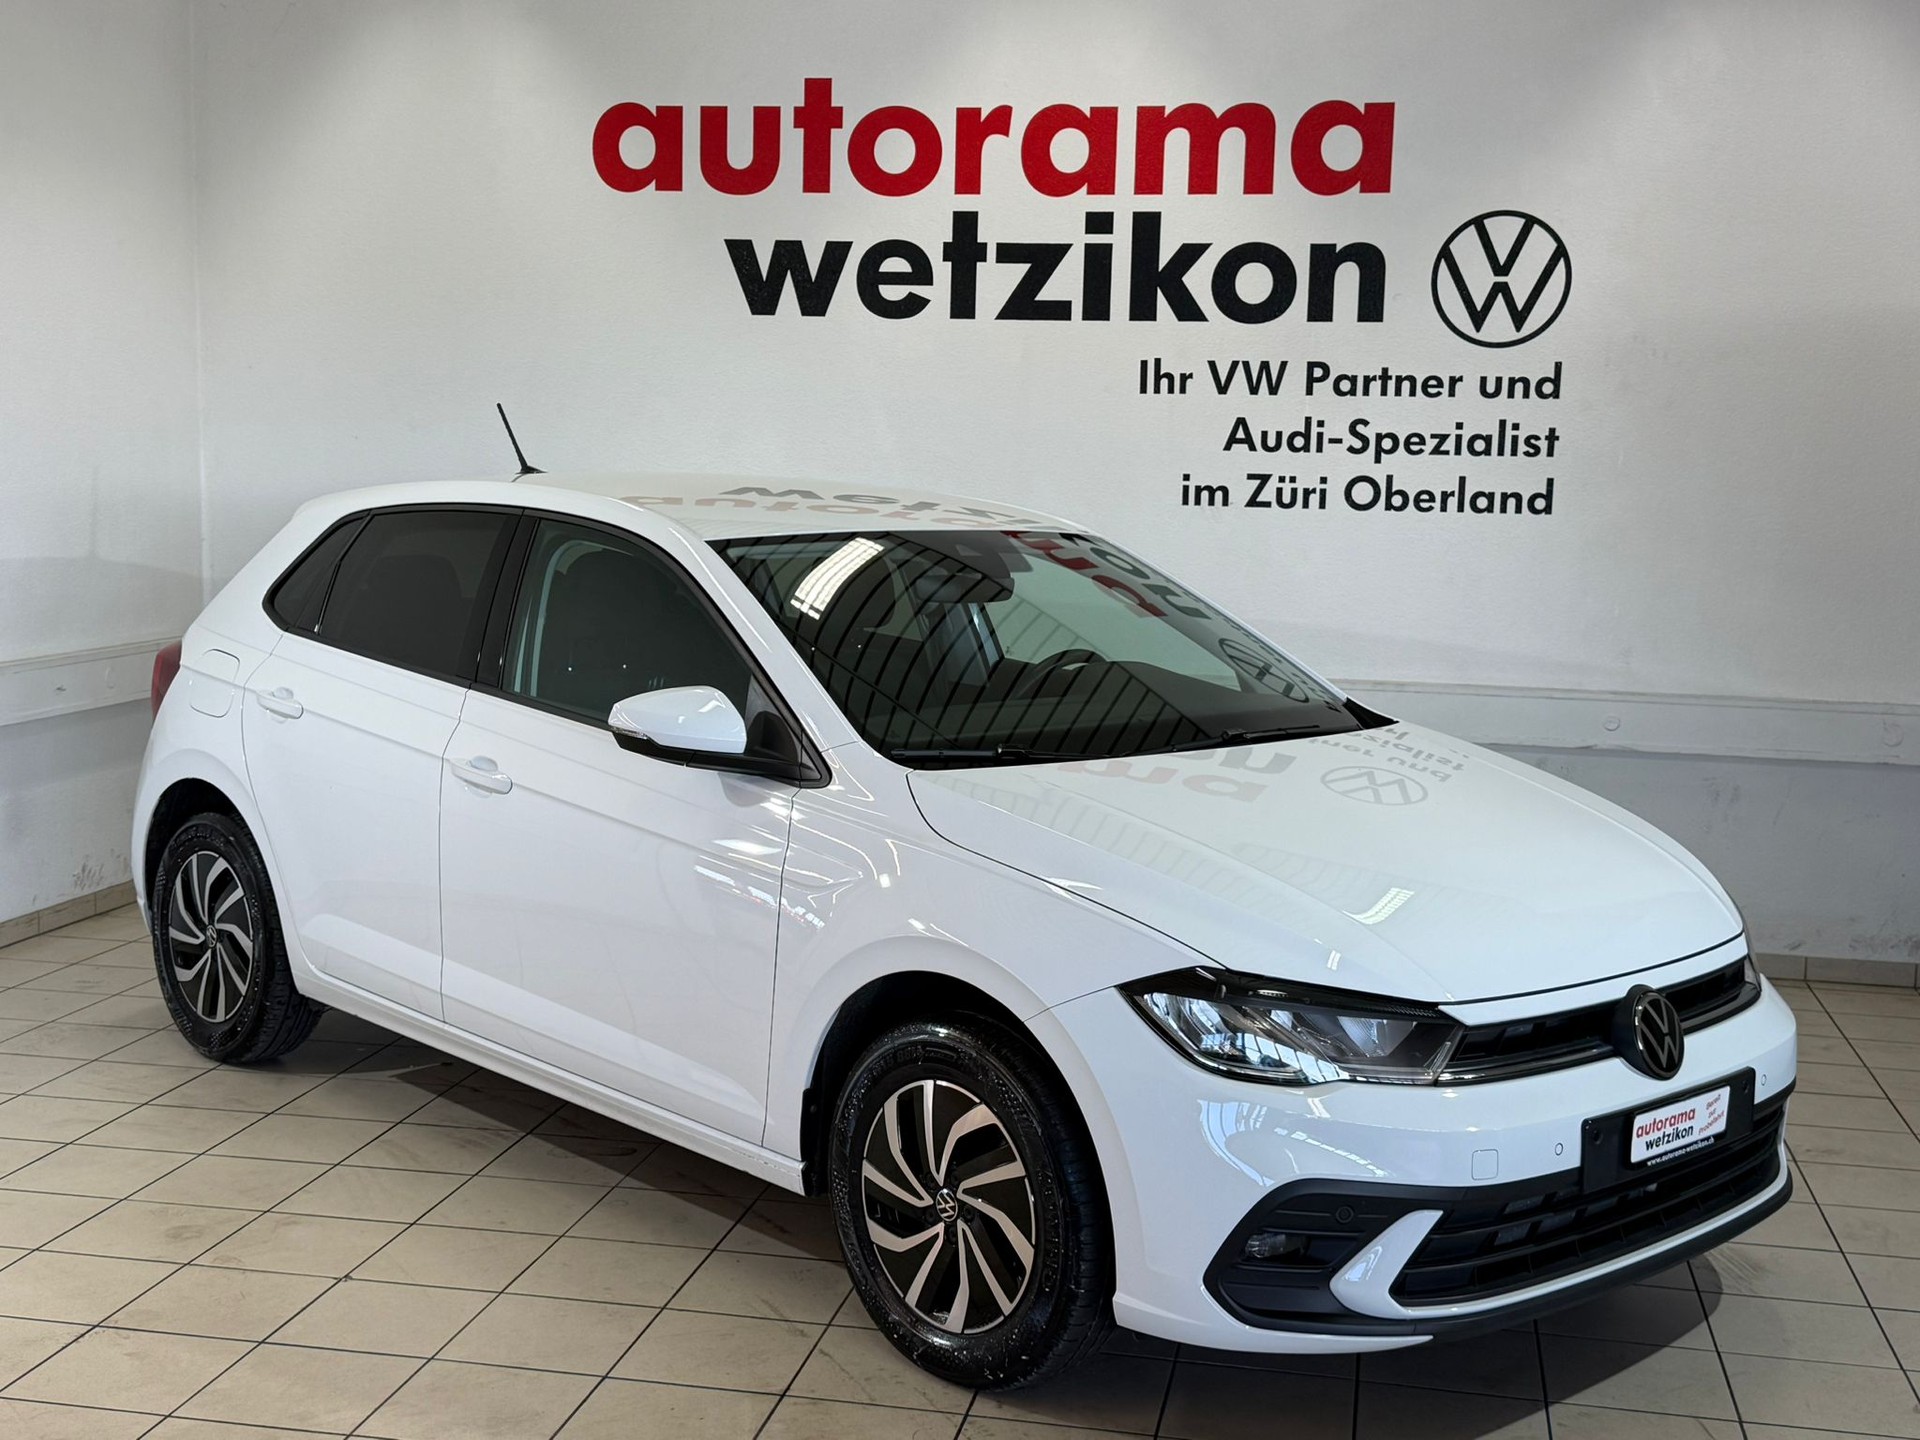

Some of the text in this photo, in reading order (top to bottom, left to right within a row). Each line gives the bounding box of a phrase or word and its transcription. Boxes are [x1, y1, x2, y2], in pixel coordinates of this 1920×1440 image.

[593, 78, 1396, 197] autorama
[725, 211, 1387, 325] wetzikon
[1139, 358, 1563, 400] Ihr VW Partner und
[1223, 416, 1560, 464] Audi-Spezialist
[1181, 473, 1555, 516] im Züri Oberland
[1636, 1108, 1696, 1138] autorama
[1645, 1125, 1694, 1151] wetzikon
